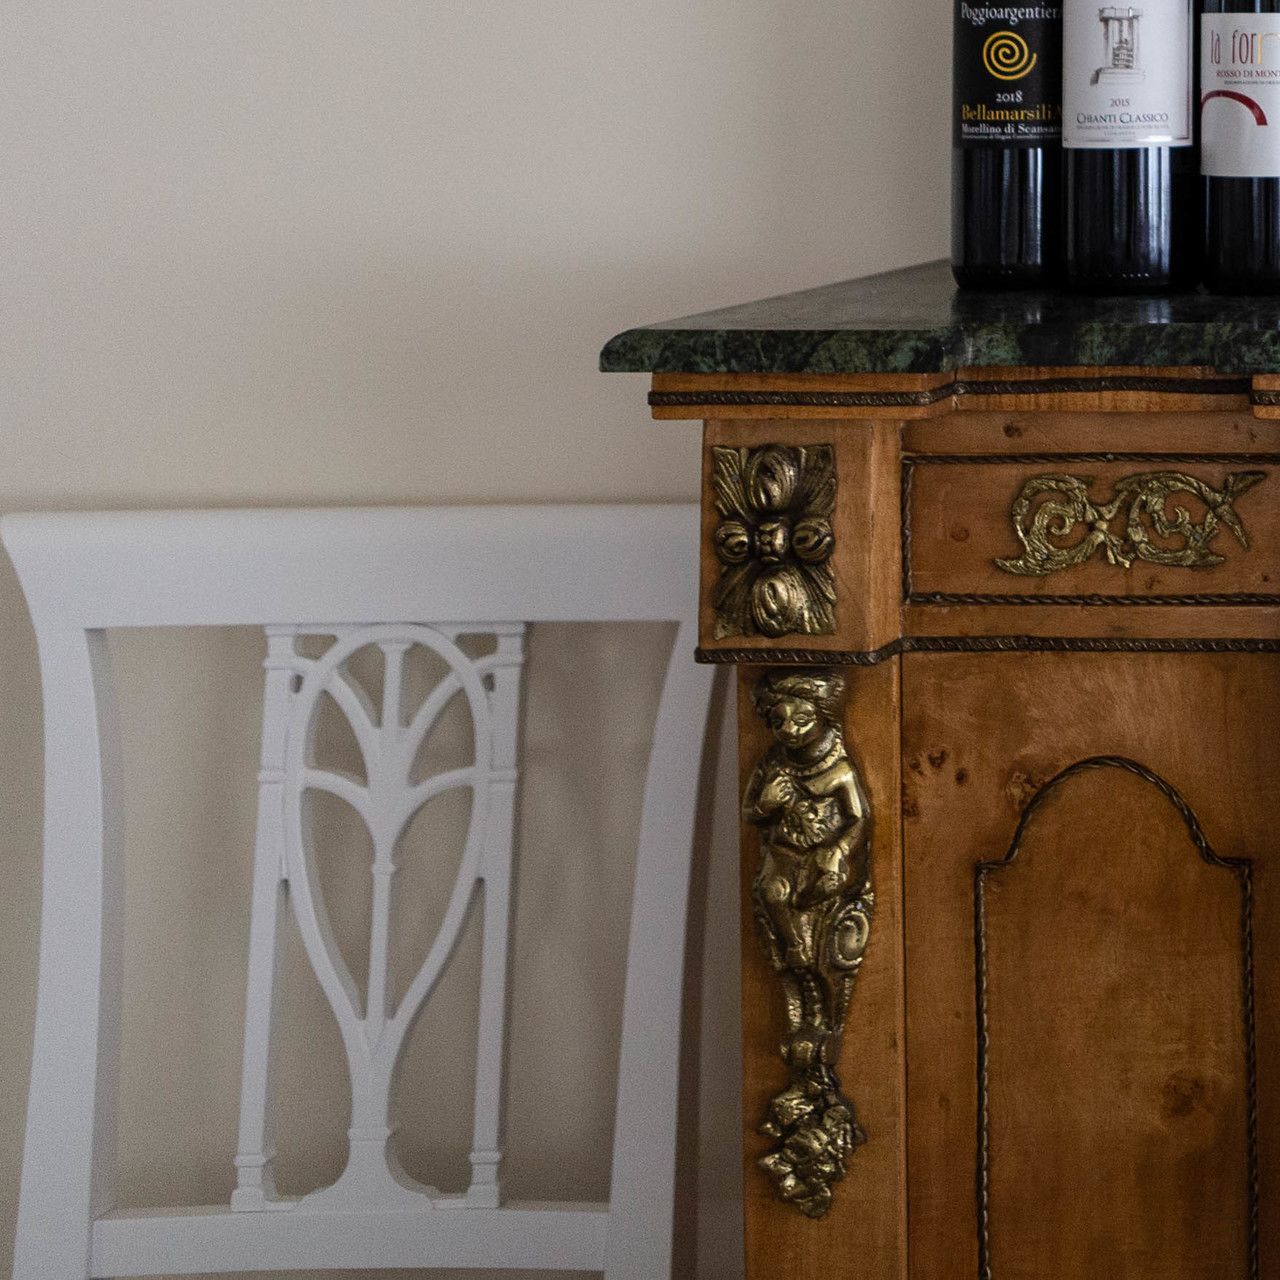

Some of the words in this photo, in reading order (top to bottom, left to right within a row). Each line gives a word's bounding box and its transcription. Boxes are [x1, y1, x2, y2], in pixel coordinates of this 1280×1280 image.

[961, 2, 1061, 25] Poggioargentier
[1210, 30, 1221, 64] la
[1216, 70, 1241, 78] ROSSO
[1243, 70, 1253, 78] DI
[996, 90, 1023, 102] 2018
[1110, 98, 1130, 107] 2015
[962, 104, 1051, 120] Bellamarsili
[962, 123, 1001, 134] Morellino
[1004, 123, 1015, 134] di
